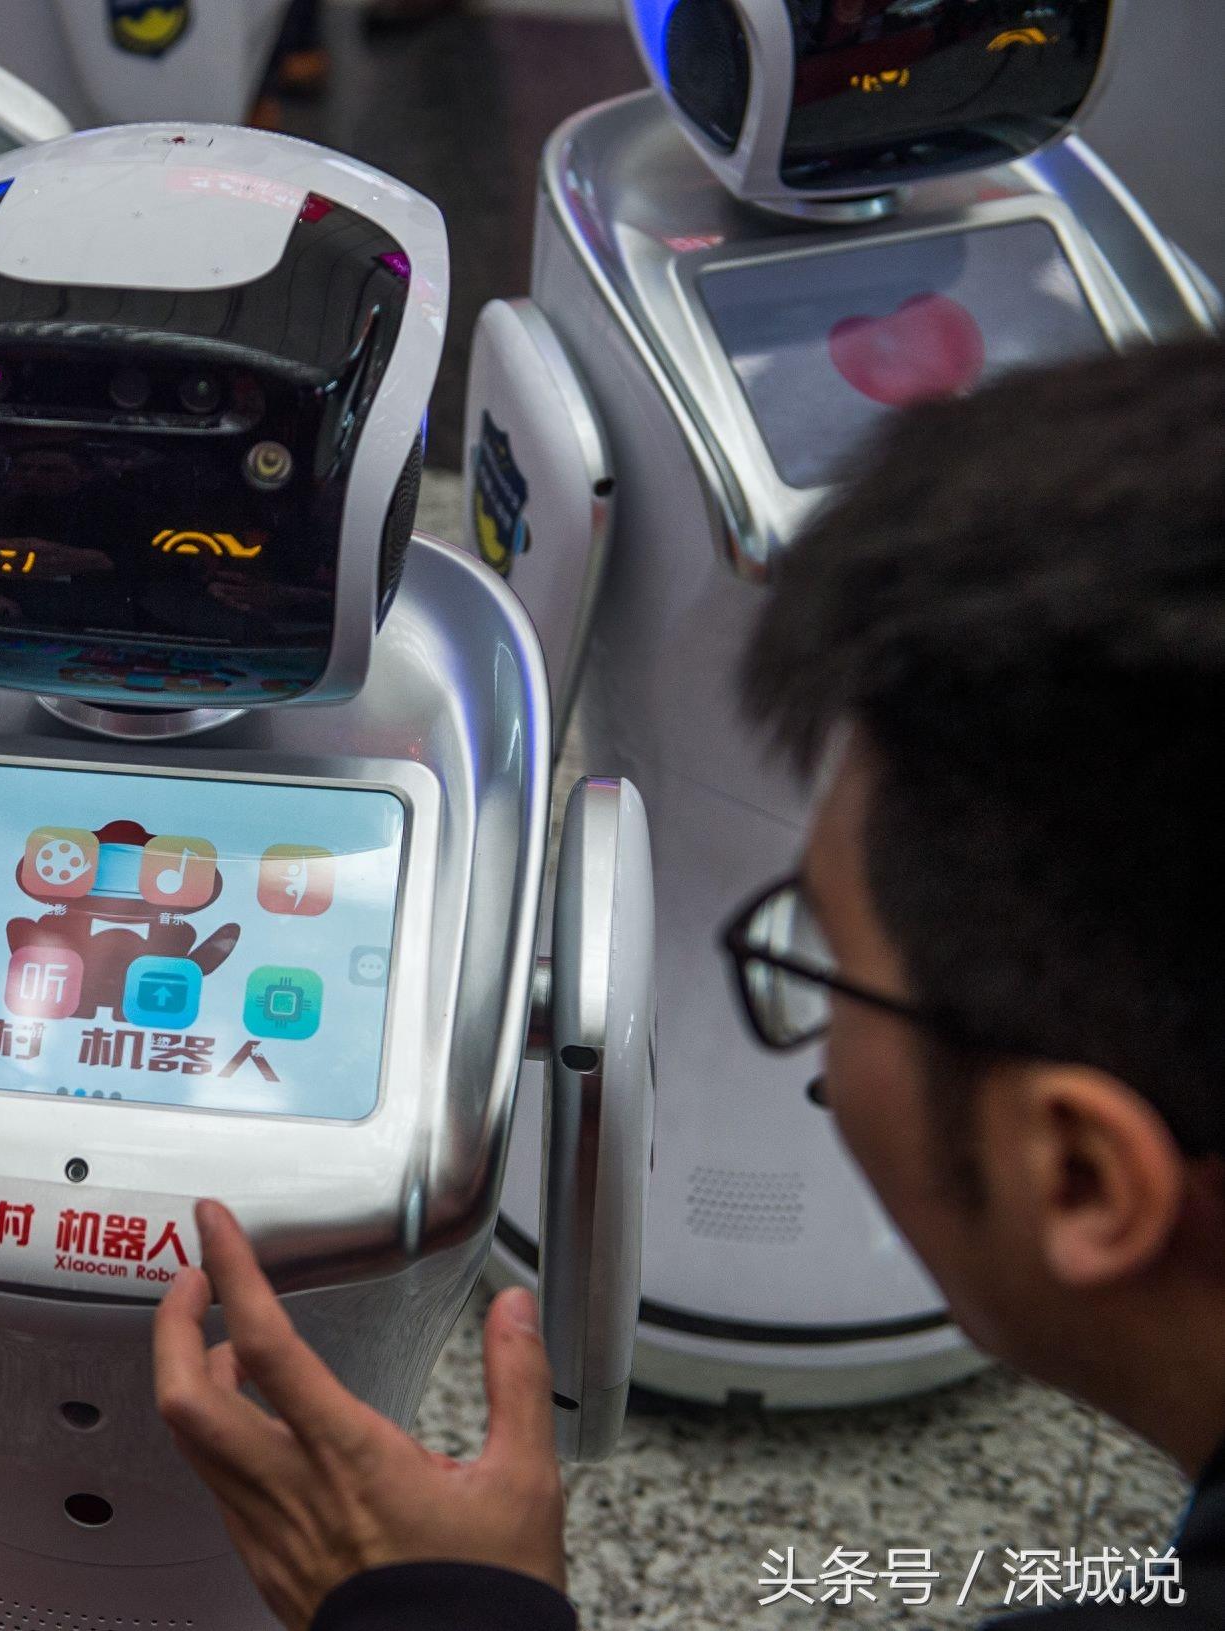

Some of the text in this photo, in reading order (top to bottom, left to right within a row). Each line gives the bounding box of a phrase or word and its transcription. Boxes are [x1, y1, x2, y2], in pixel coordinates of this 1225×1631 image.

[159, 912, 185, 926] 音乐
[20, 961, 65, 1004] 听
[78, 1027, 280, 1082] 机器人
[56, 1208, 190, 1267] 机器人
[54, 1255, 128, 1278] Xiaocun
